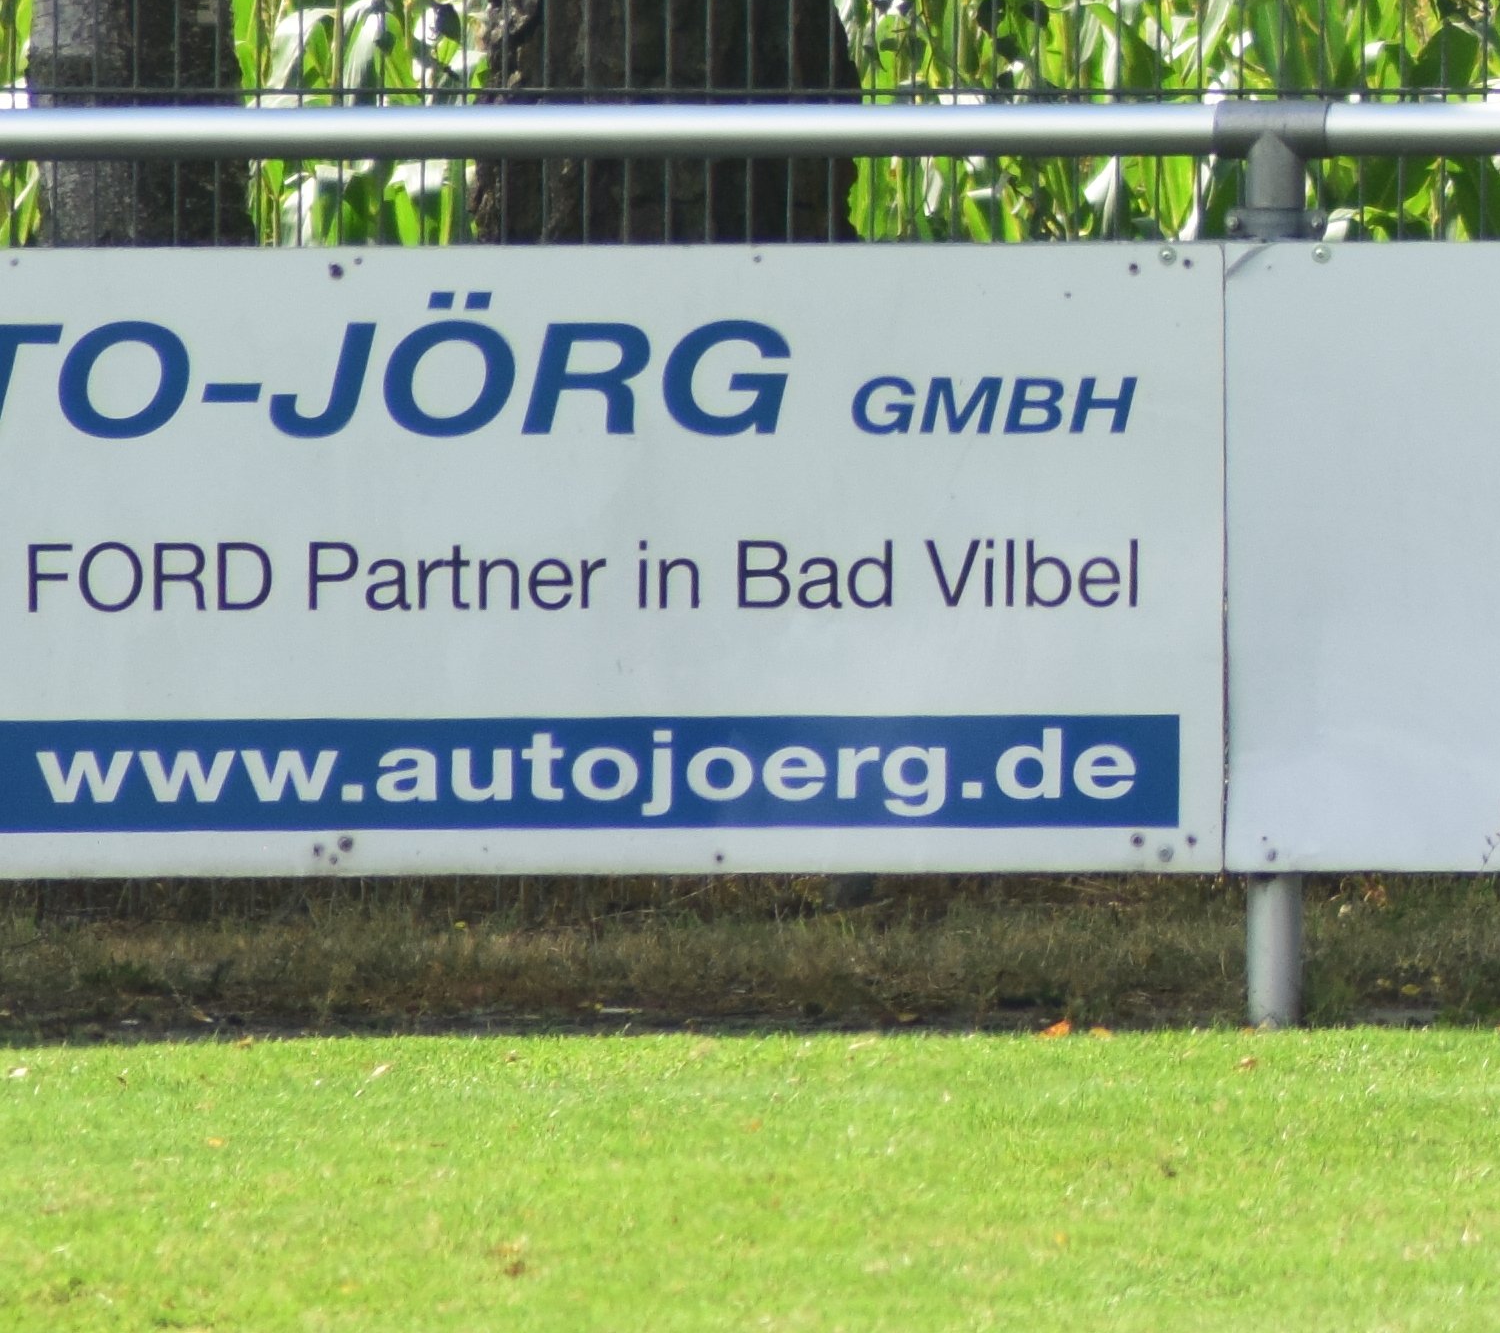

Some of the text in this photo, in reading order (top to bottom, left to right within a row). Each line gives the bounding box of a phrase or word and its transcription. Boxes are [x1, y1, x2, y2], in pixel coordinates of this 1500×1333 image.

[850, 376, 1139, 435] GMBH
[26, 538, 1139, 613] FORD Partner in Bad Vilbel
[36, 727, 1137, 817] www.autojoerg.de
